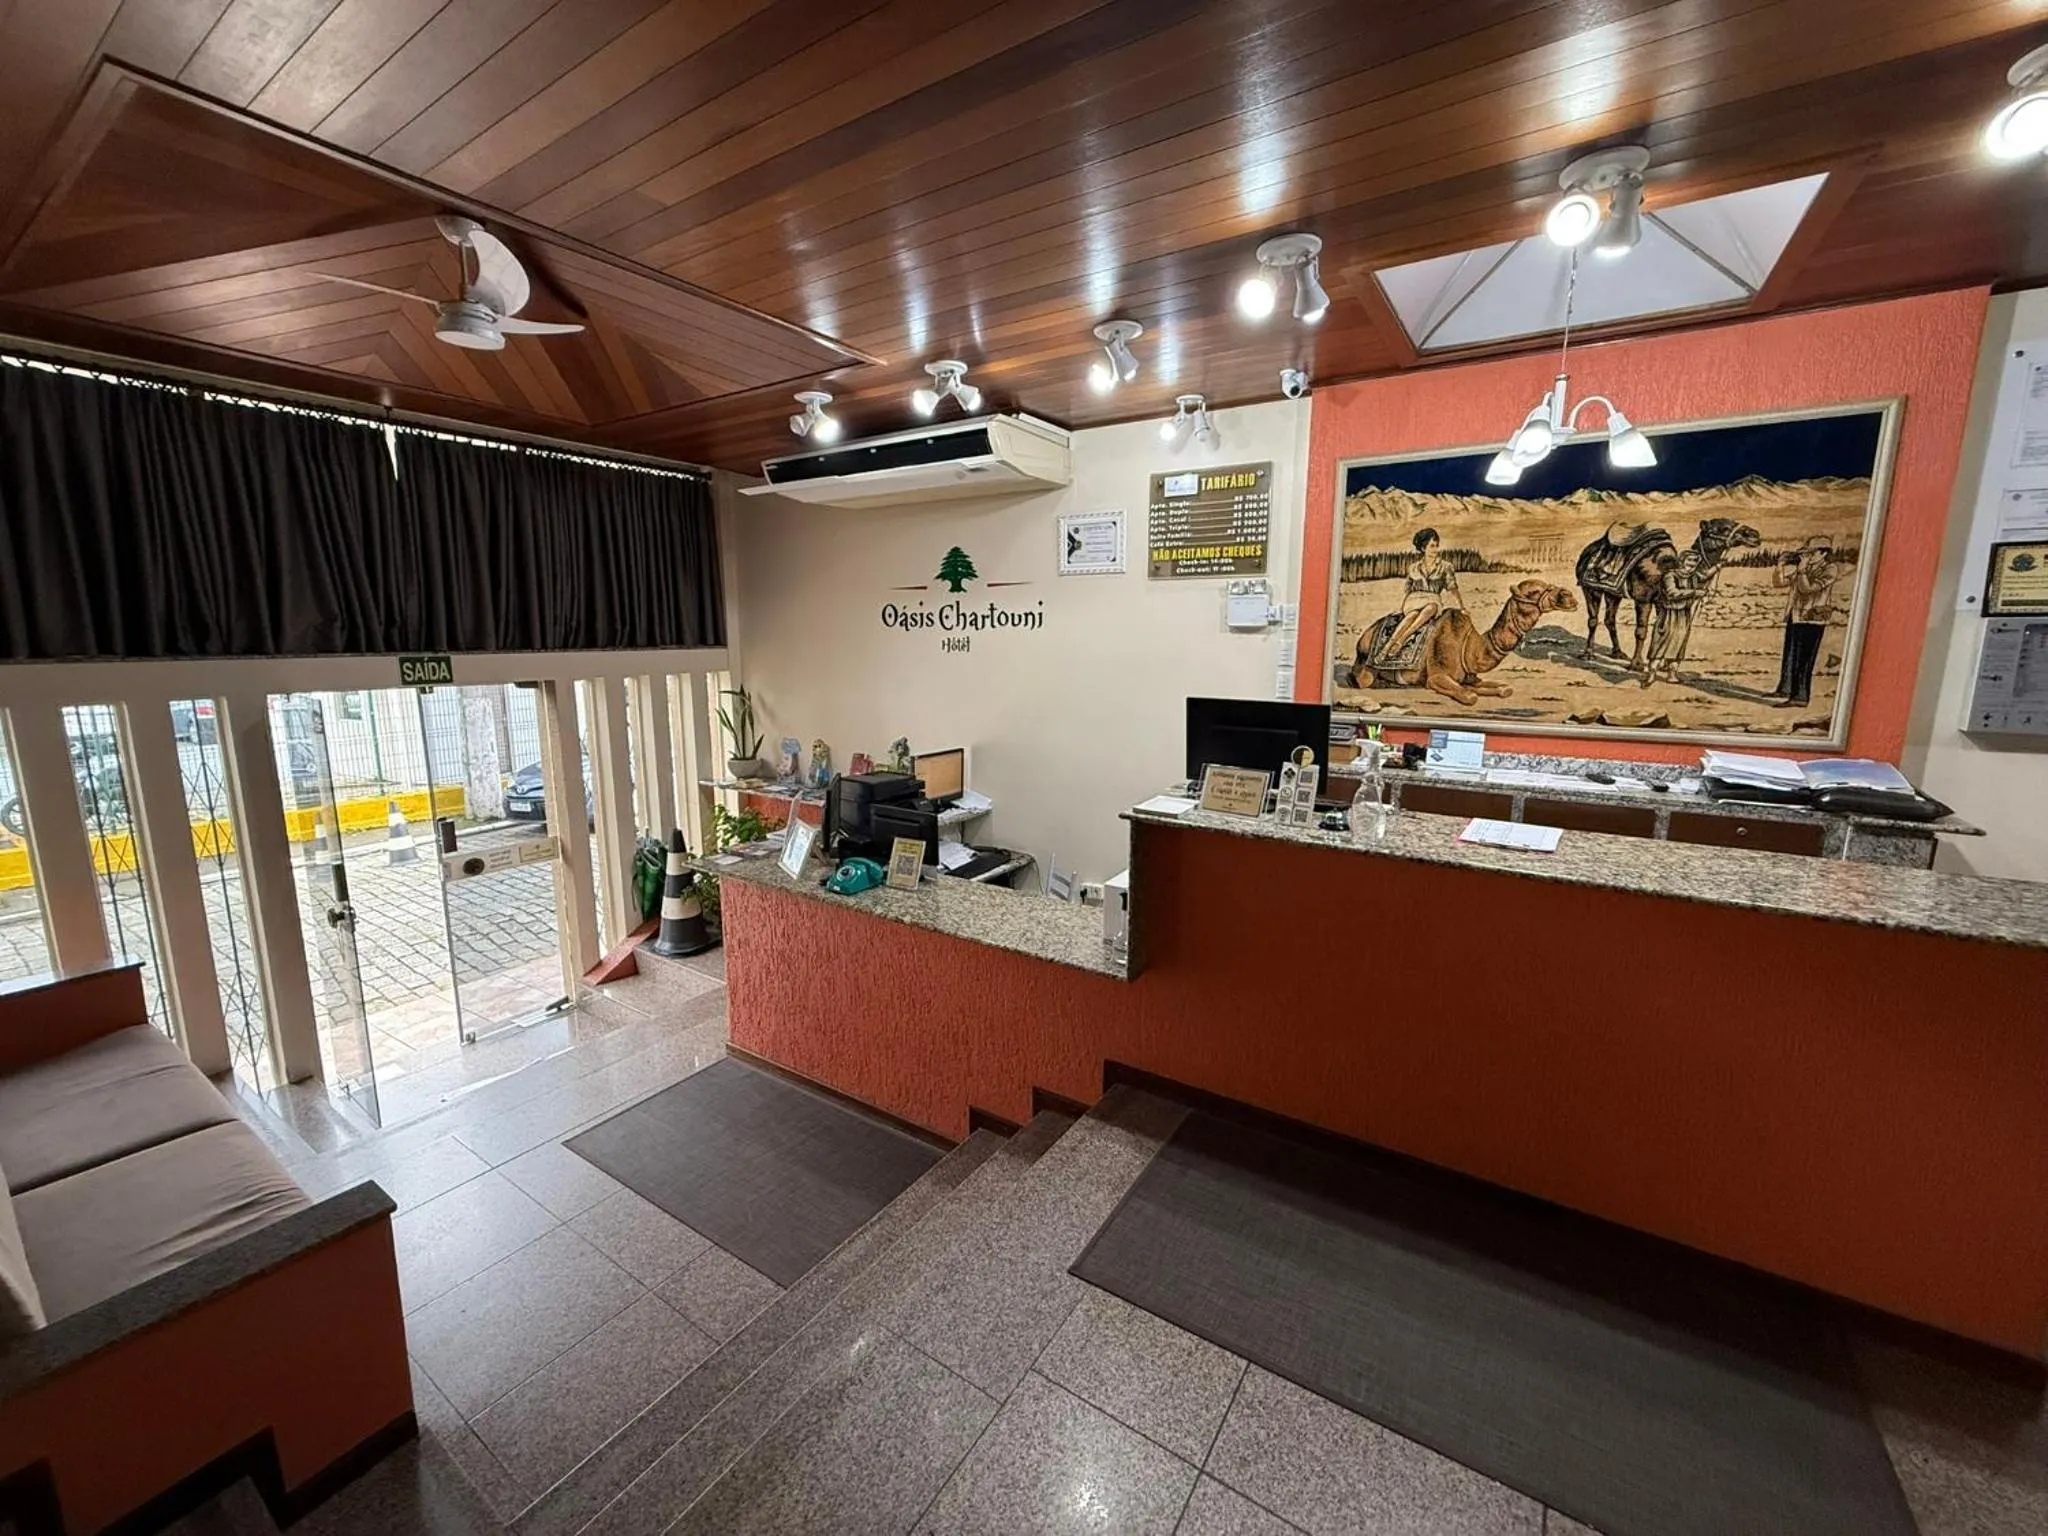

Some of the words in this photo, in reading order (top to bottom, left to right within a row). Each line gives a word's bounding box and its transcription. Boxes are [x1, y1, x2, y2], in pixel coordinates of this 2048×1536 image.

[1200, 472, 1256, 491] TARIFÁRIO
[1152, 548, 1170, 561] NÃO
[1171, 546, 1221, 561] ACEITAMOS
[1222, 544, 1262, 558] CHEQUES
[881, 600, 935, 632] Oásis
[938, 600, 1044, 631] Chartouni
[402, 657, 451, 682] SAÍDA
